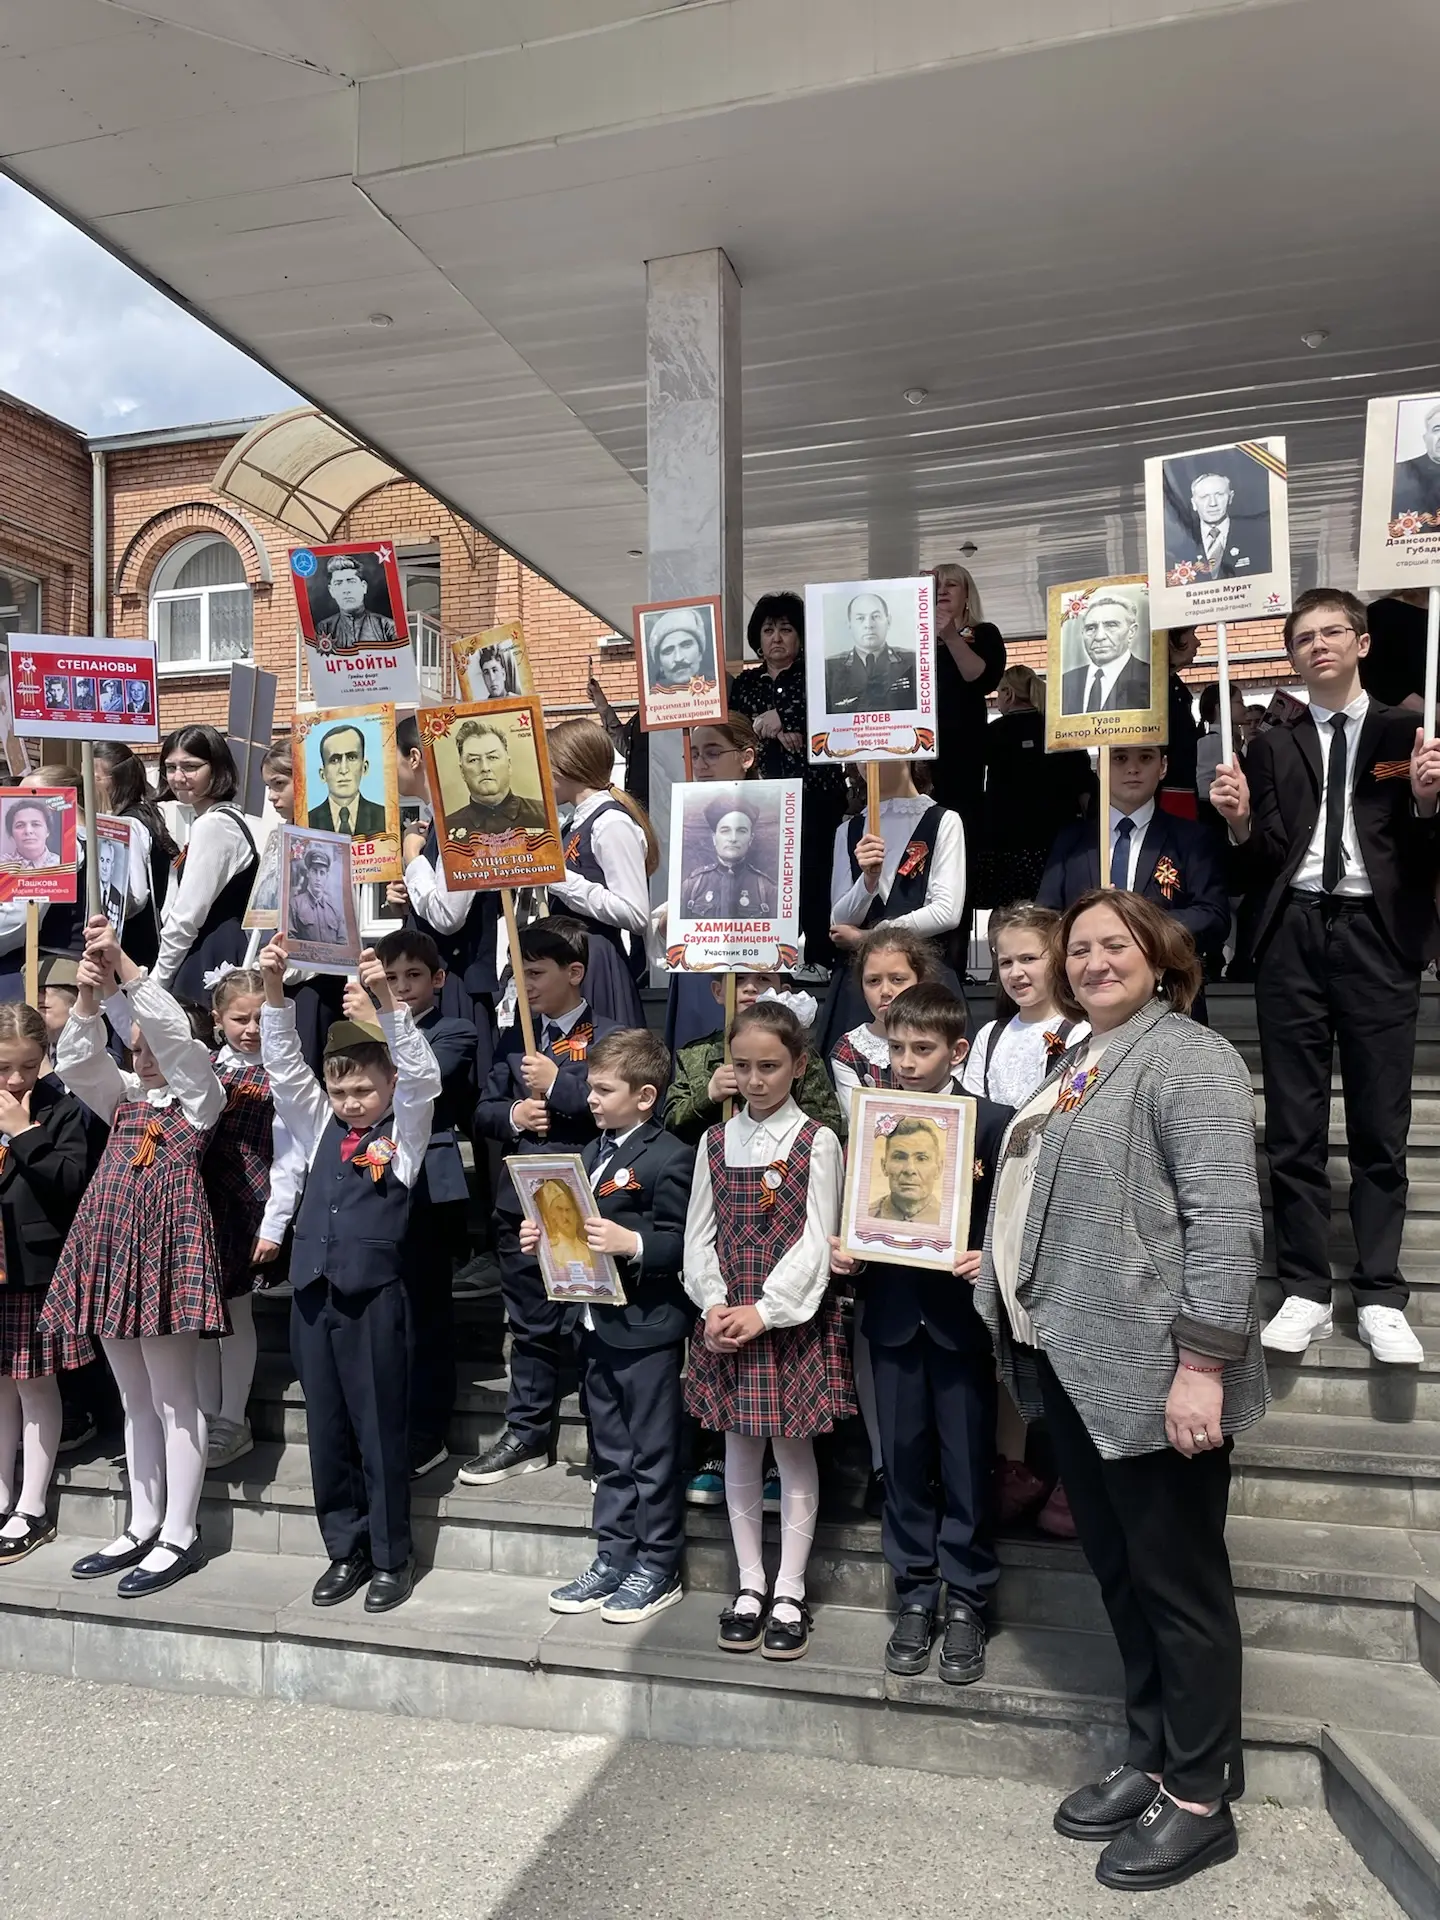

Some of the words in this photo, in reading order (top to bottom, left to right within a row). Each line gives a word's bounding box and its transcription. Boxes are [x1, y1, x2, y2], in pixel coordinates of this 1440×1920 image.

[1223, 583, 1252, 593] Мурат
[918, 587, 929, 619] ПОЛК
[1192, 594, 1246, 606] Мазанович
[1184, 607, 1215, 617] старший
[57, 659, 137, 673] СТЕПАНОВЫ
[326, 654, 397, 674] ЦГЪОЙТЫ
[917, 624, 931, 714] БЕССМЕРТНЫЙ
[655, 710, 714, 722] Александрович
[853, 713, 891, 725] ДЗГОЕВ
[1090, 716, 1121, 726] Туаев
[1055, 728, 1091, 739] Виктор
[1094, 726, 1161, 736] Кириллович
[785, 792, 796, 823] ПОЛК
[471, 853, 534, 868] ХУЦИСТОВ
[452, 869, 490, 881] Мухтар
[491, 864, 556, 878] Таузбекович
[782, 829, 796, 919] БЕССМЕРТНЫЙ
[18, 879, 58, 887] Пашкова
[695, 921, 771, 934] ХАМИЦАЕВ
[683, 934, 720, 944] Саухал
[723, 934, 780, 944] Хамицевич
[704, 948, 741, 957] Участник
[742, 948, 759, 956] ВОВ
